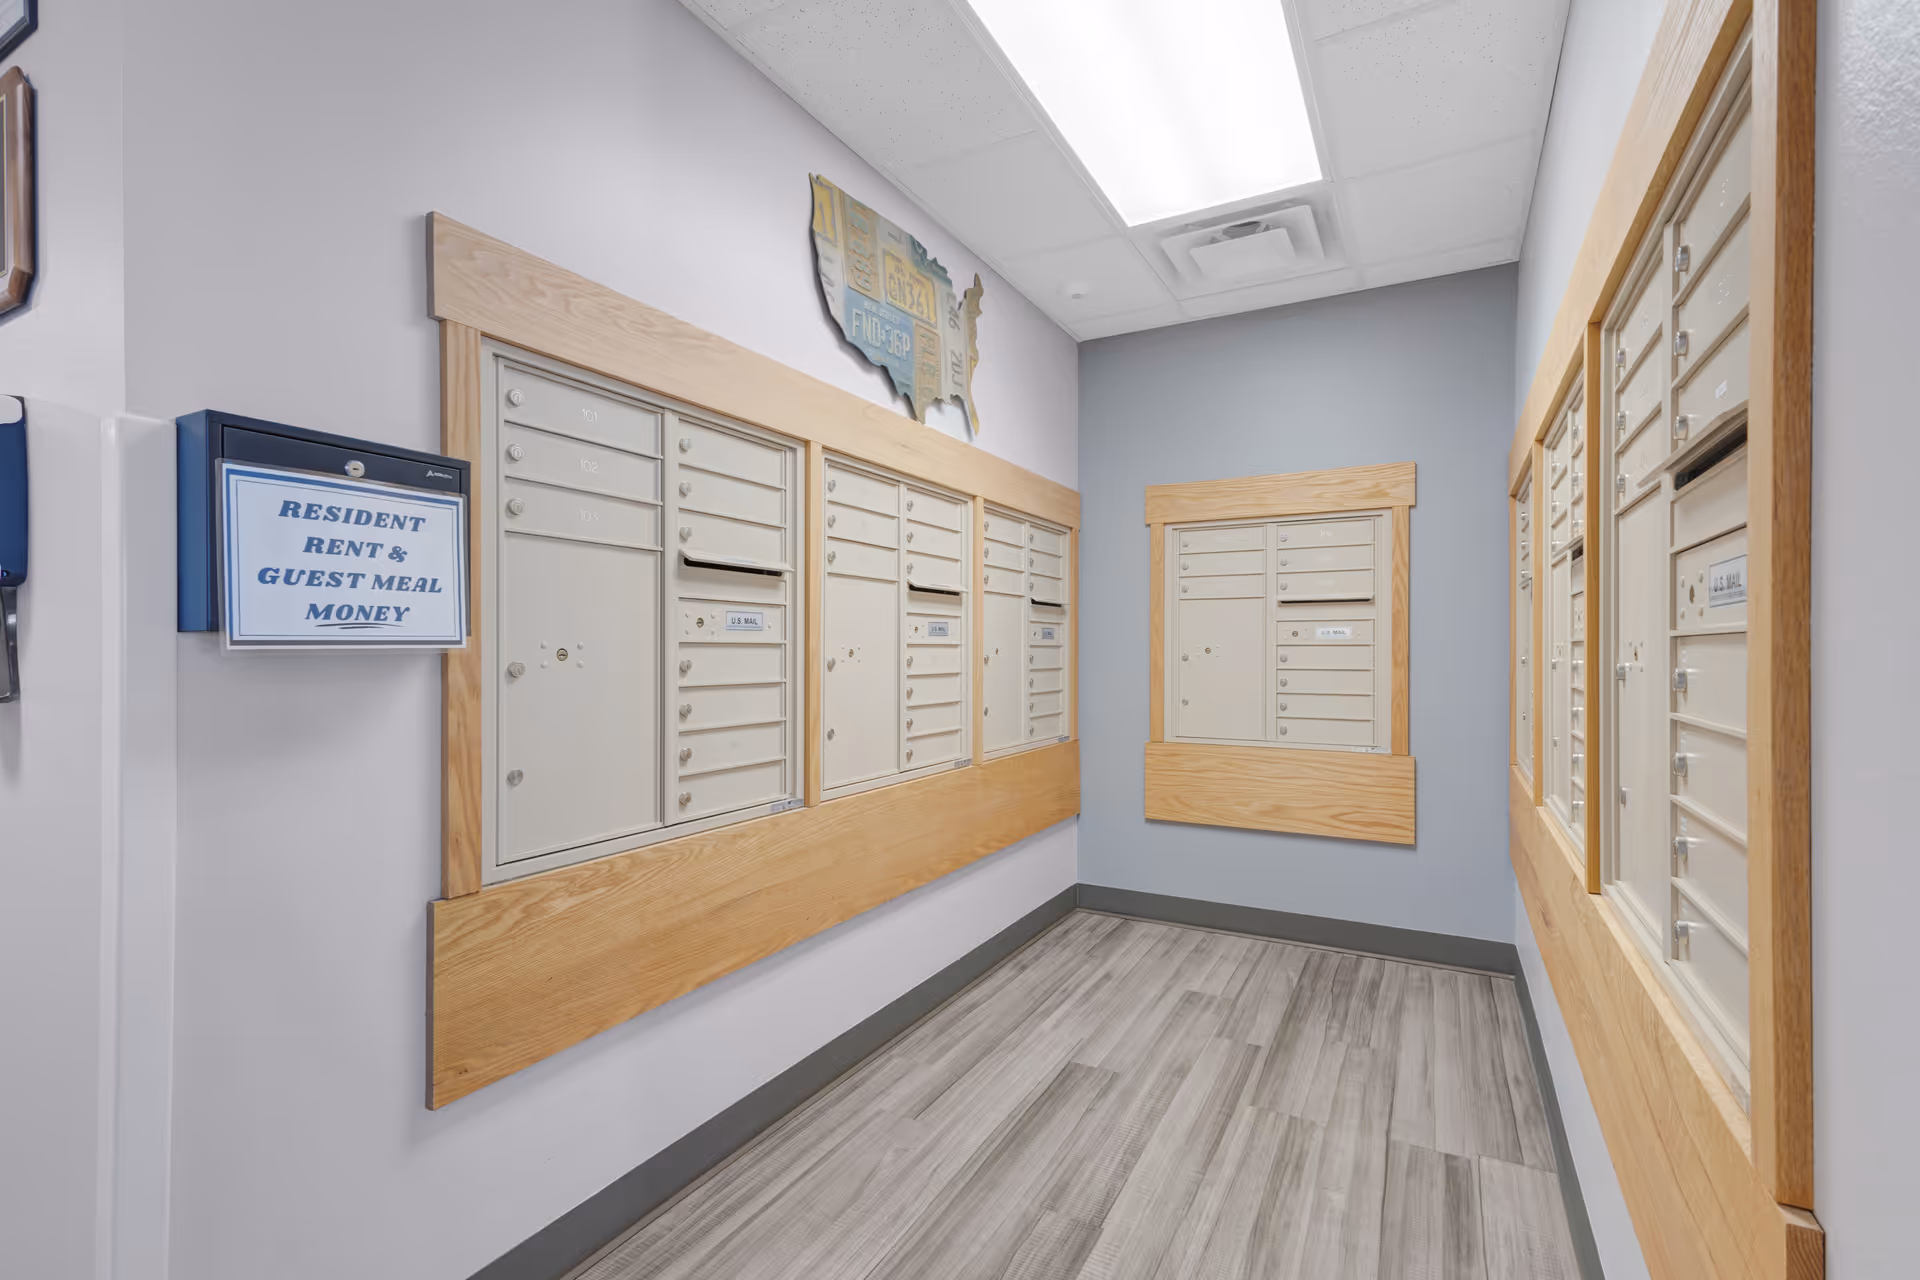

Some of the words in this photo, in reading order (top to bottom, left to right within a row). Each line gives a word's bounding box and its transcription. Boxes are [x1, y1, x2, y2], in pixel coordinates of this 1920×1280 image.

[278, 500, 426, 532] RESIDENT
[303, 536, 384, 559] RENT
[388, 545, 408, 562] &
[257, 567, 366, 590] GUEST
[371, 574, 443, 593] MEAL
[1713, 575, 1726, 592] U.S.
[1726, 571, 1742, 589] MAIL
[304, 603, 411, 622] MONEY
[731, 616, 743, 625] U.S.
[744, 616, 759, 625] MAIL
